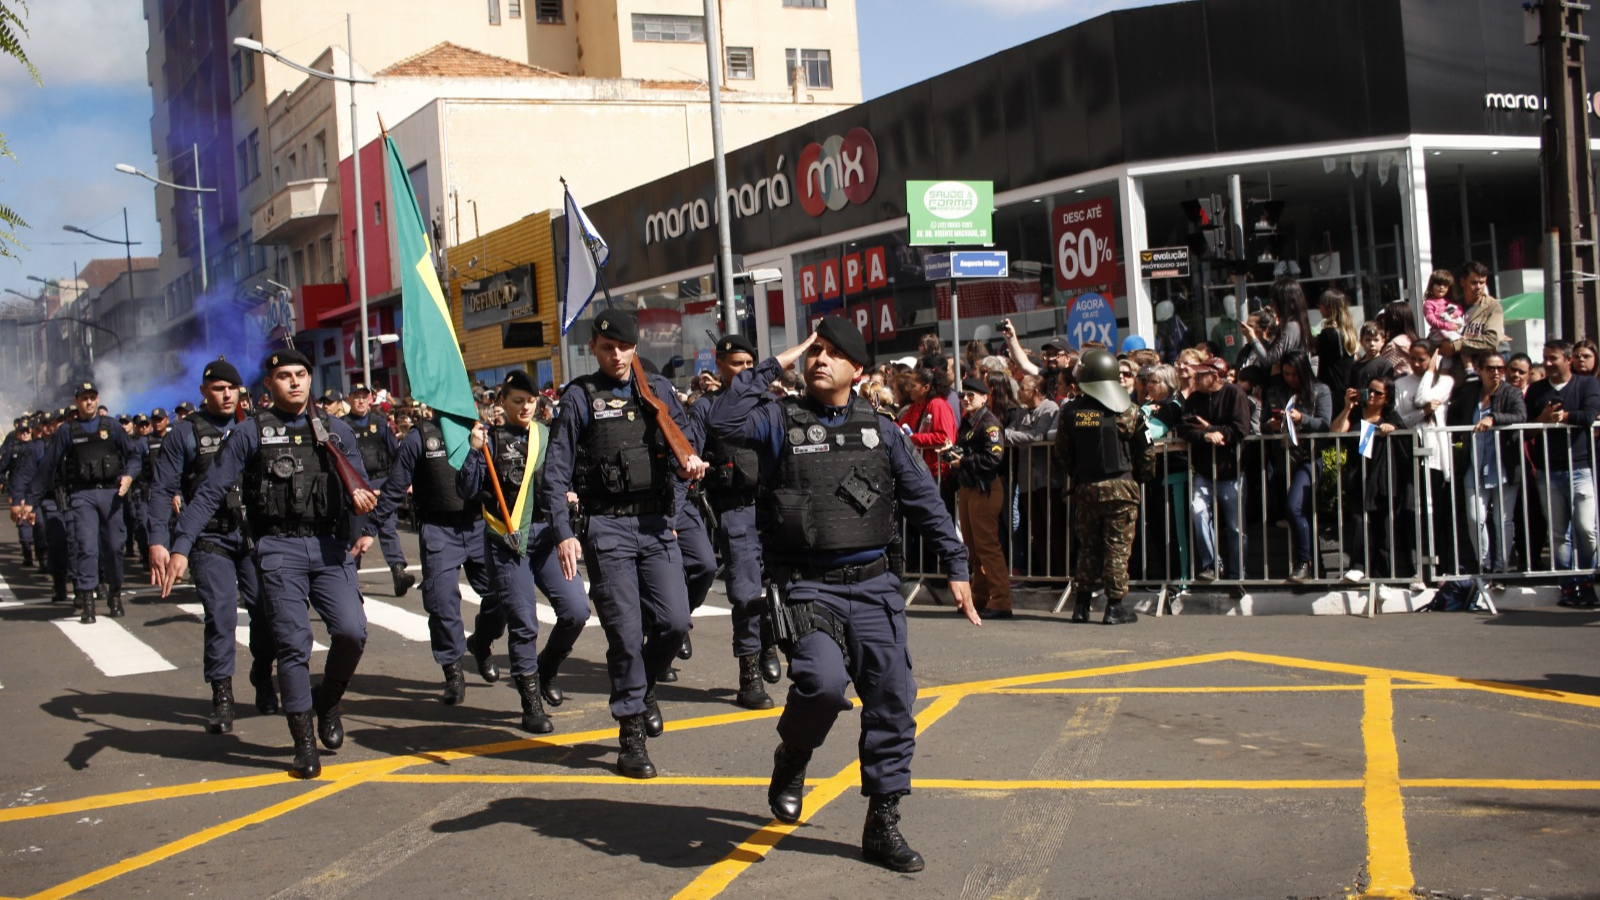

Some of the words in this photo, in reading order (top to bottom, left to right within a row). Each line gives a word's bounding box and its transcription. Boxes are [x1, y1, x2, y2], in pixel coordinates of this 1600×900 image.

[1485, 93, 1539, 110] maria
[645, 198, 710, 245] maria
[806, 146, 865, 199] mix
[967, 190, 973, 198] &
[1063, 210, 1085, 224] DESC
[1086, 204, 1102, 220] ATÉ
[1058, 228, 1112, 280] 60%
[1153, 250, 1187, 260] evolução
[1141, 262, 1175, 270] PROTEGIDO
[803, 253, 884, 298] RAPA
[1076, 299, 1104, 312] AGORA
[1073, 321, 1113, 350] 12X
